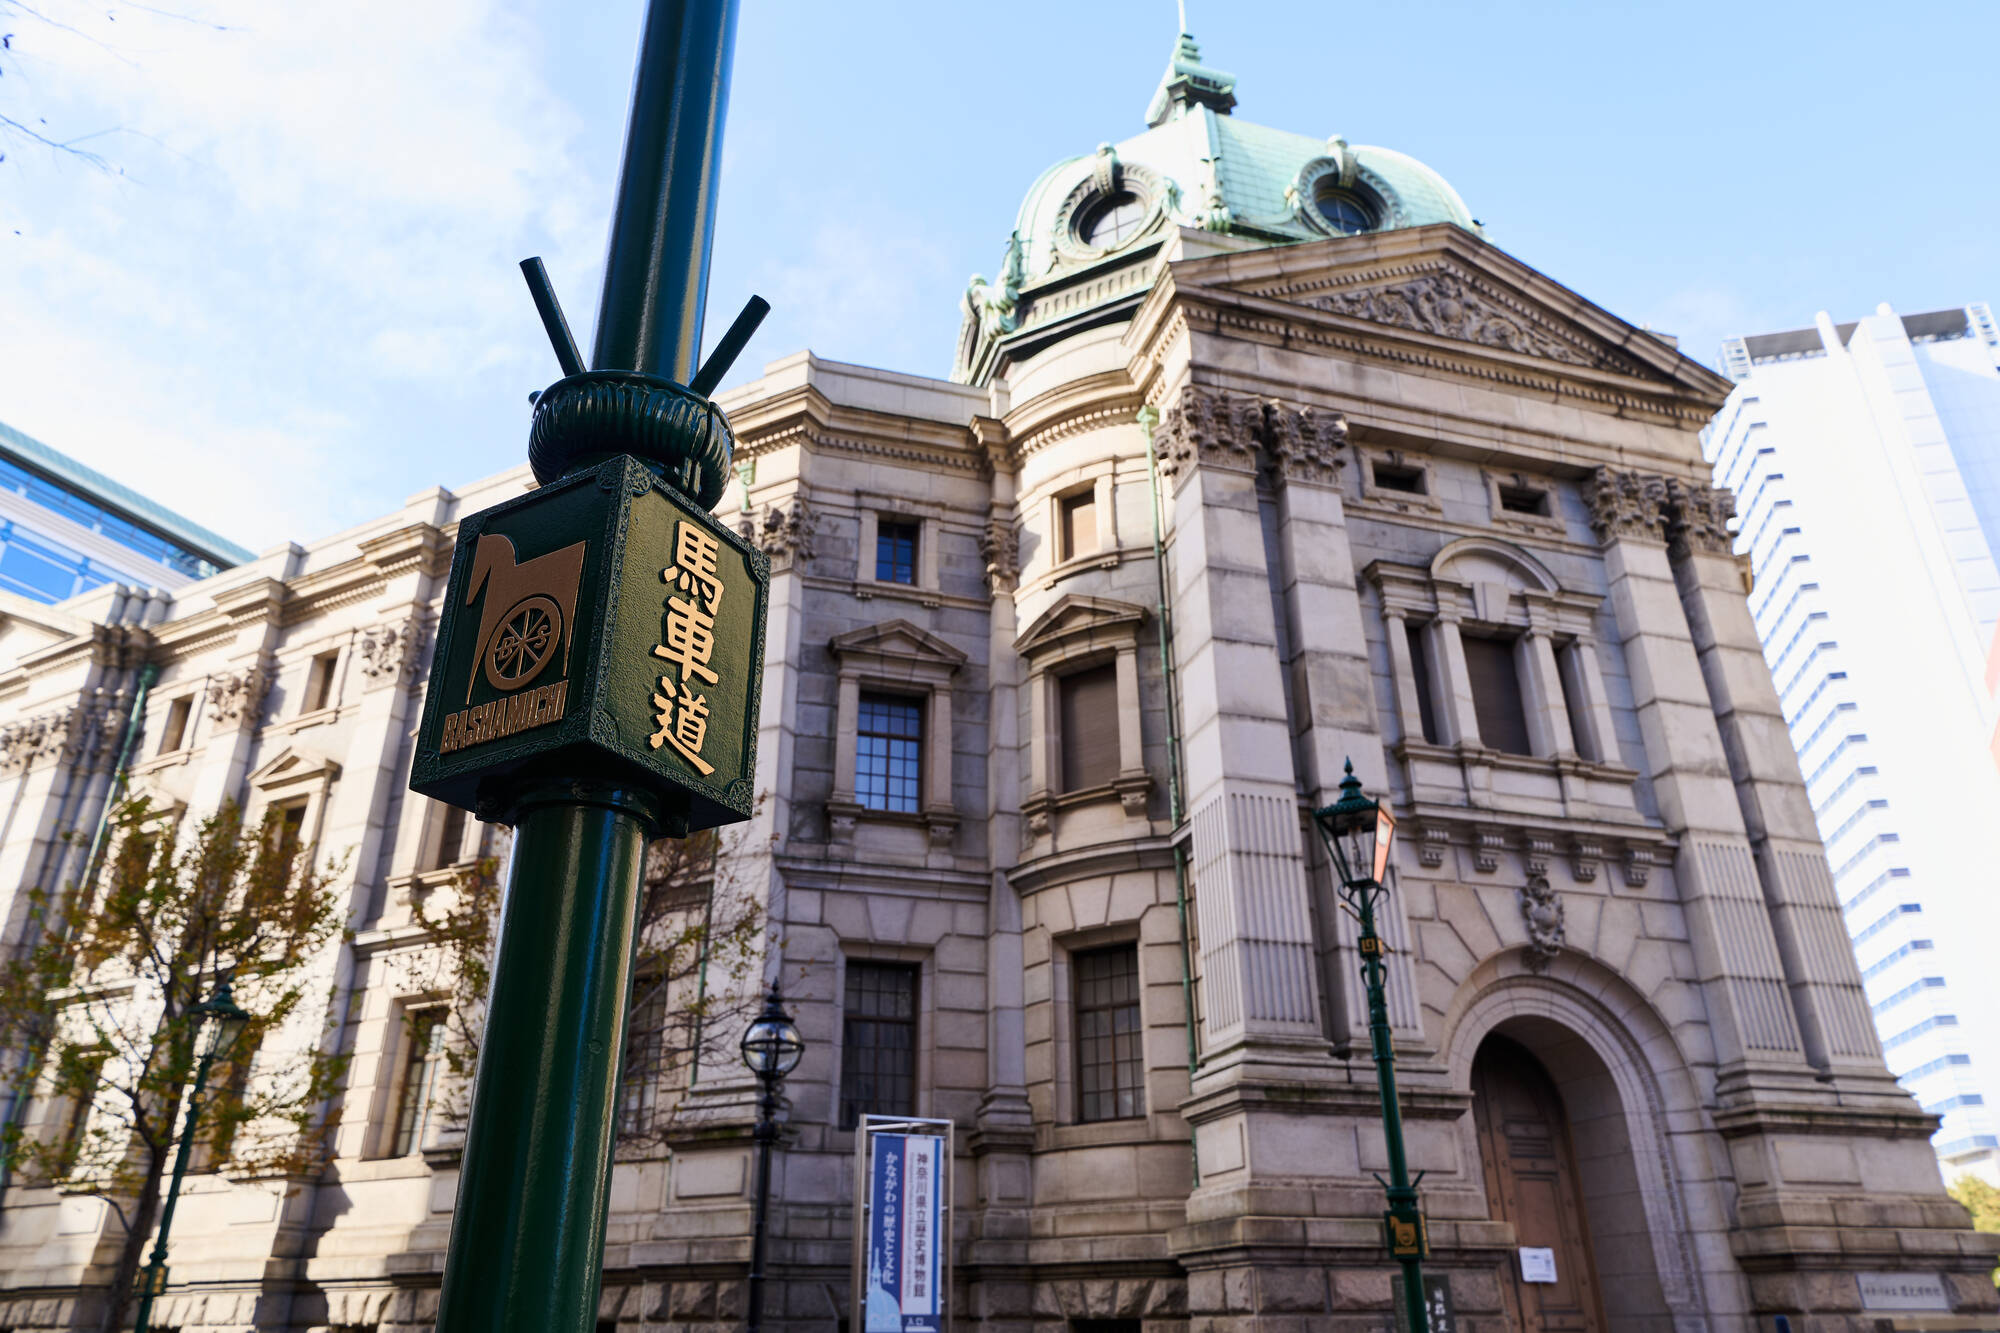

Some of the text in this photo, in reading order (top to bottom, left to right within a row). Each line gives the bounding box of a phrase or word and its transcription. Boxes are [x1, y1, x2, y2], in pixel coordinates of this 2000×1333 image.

[440, 680, 568, 754] BASHAMICHI
[650, 520, 725, 776] 馬車道
[913, 1152, 928, 1298] 神奈川県立歴史博物館
